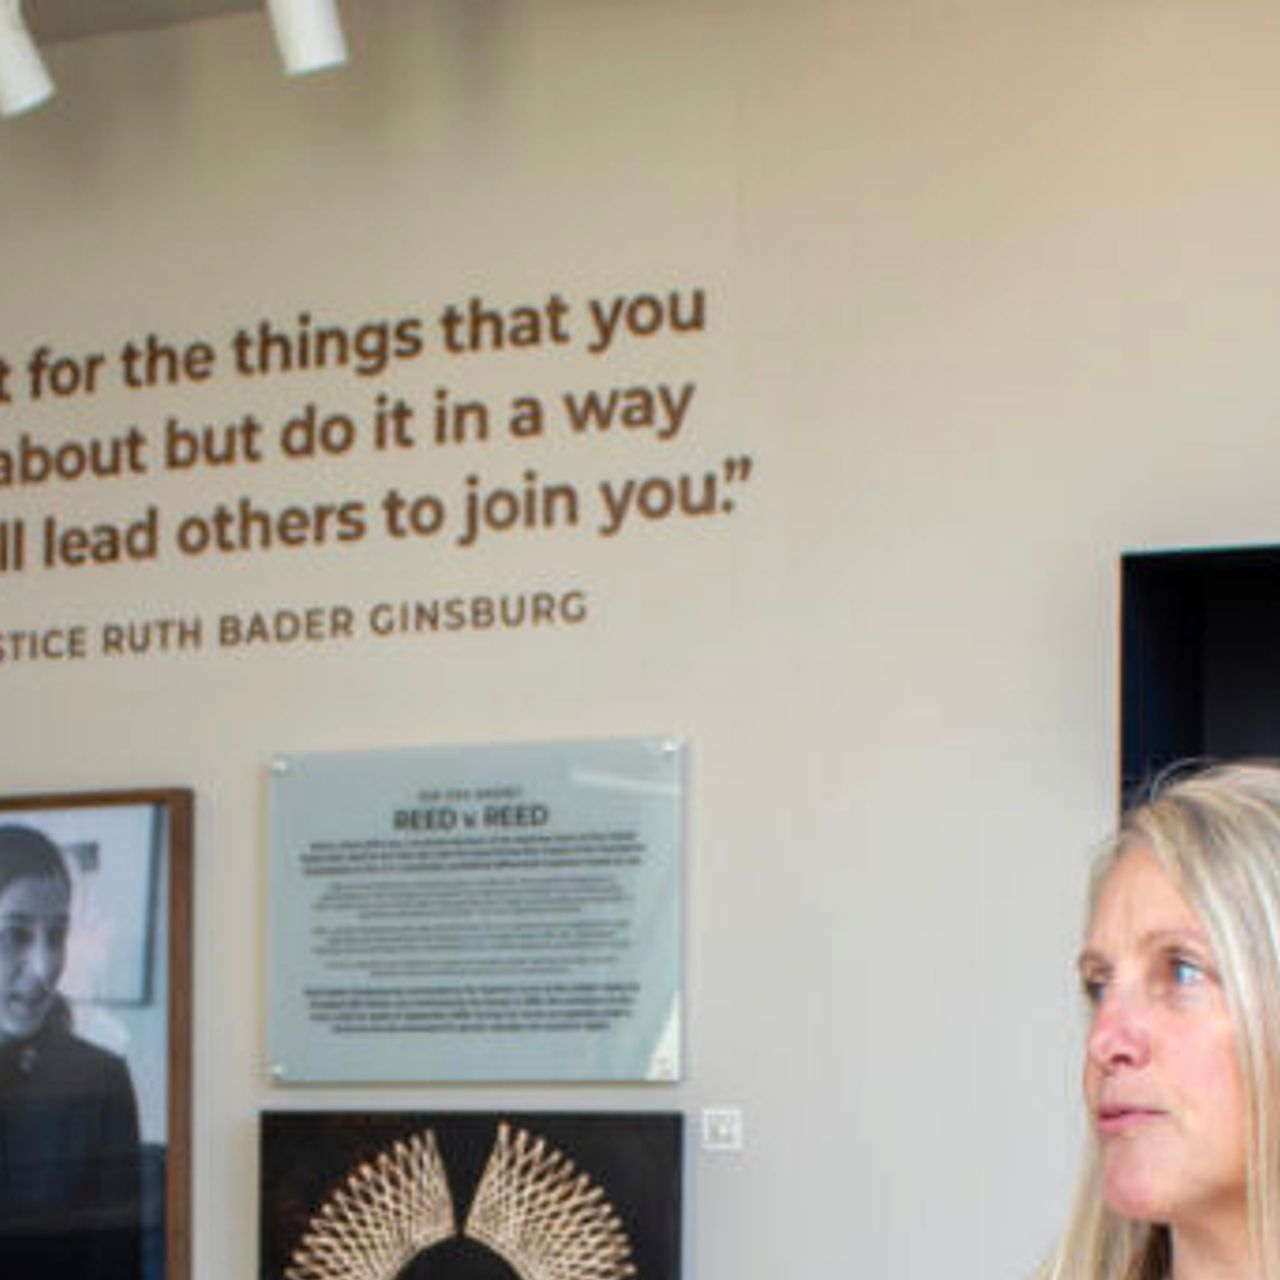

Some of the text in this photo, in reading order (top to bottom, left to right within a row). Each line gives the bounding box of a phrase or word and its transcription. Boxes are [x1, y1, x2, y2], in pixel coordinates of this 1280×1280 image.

[27, 346, 105, 400] for
[121, 334, 215, 388] the
[232, 313, 423, 377] things
[440, 295, 569, 354] that
[588, 290, 705, 349] you
[166, 416, 261, 470] but
[280, 404, 355, 458] do
[375, 394, 414, 450] it
[435, 389, 488, 445] in
[510, 398, 542, 437] a
[563, 384, 695, 440] way
[44, 506, 158, 568] lead
[177, 498, 366, 555] others
[382, 490, 445, 538] to
[457, 470, 578, 547] join
[600, 455, 752, 537] you.”
[102, 618, 202, 655] RUTH
[219, 606, 354, 646] BADER
[369, 590, 587, 636] GINSBURG
[393, 808, 458, 831] REED
[483, 803, 550, 827] REED
